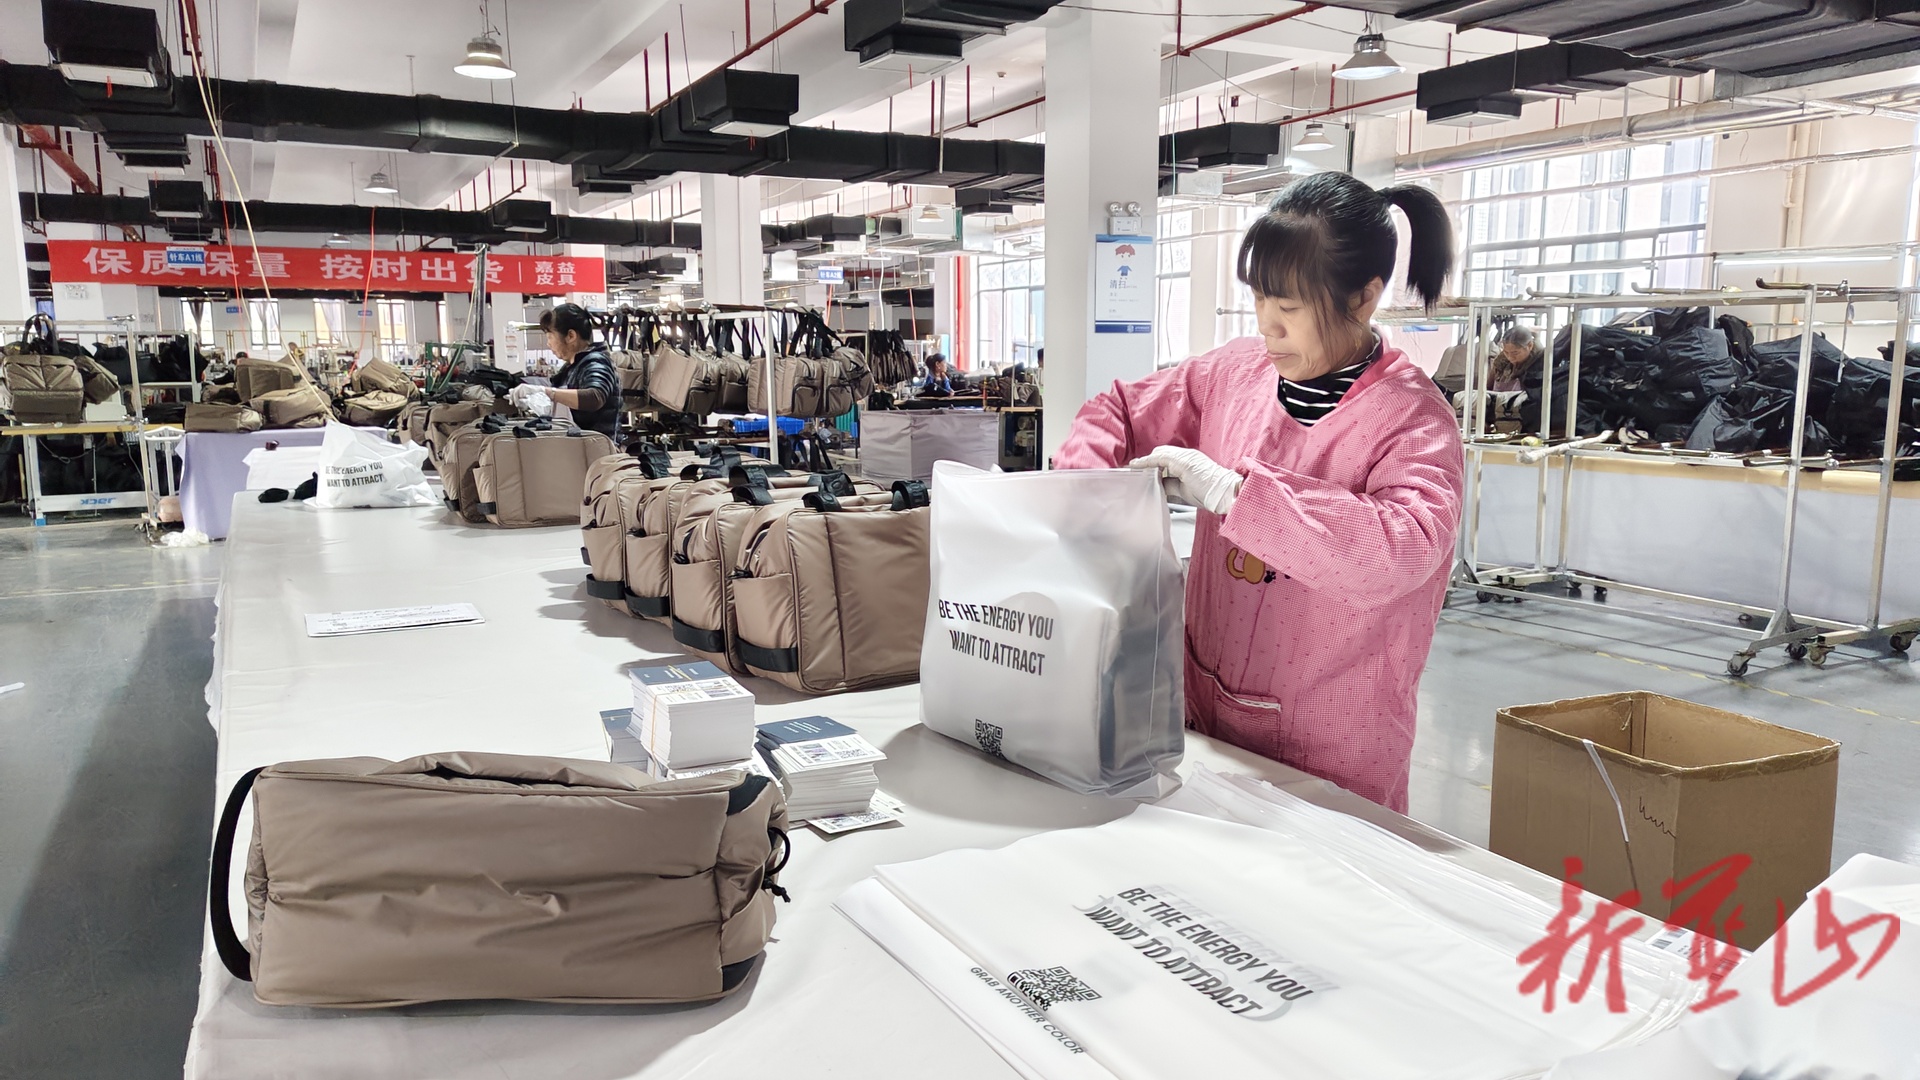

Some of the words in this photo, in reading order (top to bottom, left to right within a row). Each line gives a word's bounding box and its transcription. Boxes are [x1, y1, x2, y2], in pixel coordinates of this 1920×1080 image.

[82, 246, 291, 278] 保质保量
[319, 253, 505, 285] 按时出货
[534, 260, 576, 274] 嘉益
[534, 273, 577, 286] 皮具
[341, 478, 350, 488] TO
[351, 473, 384, 487] ATTRACT
[368, 462, 383, 471] YOU
[938, 598, 955, 620] BE
[952, 602, 981, 623] THE
[980, 604, 1026, 634] ENERGY
[1027, 613, 1054, 641] YOU
[949, 629, 978, 657] WANT
[978, 637, 991, 661] TO
[991, 642, 1046, 676] ATTRACT
[1084, 906, 1150, 942] WANT
[1132, 937, 1172, 959] TO
[1154, 956, 1264, 1015] ATTRACT
[1117, 887, 1157, 906] BE
[1142, 901, 1193, 928] THE
[1175, 923, 1269, 972] ENERGY
[1254, 968, 1314, 1001] YOU
[970, 966, 1000, 988] GRAB
[995, 987, 1046, 1023] ANOTHER
[1042, 1024, 1084, 1055] COLOR
